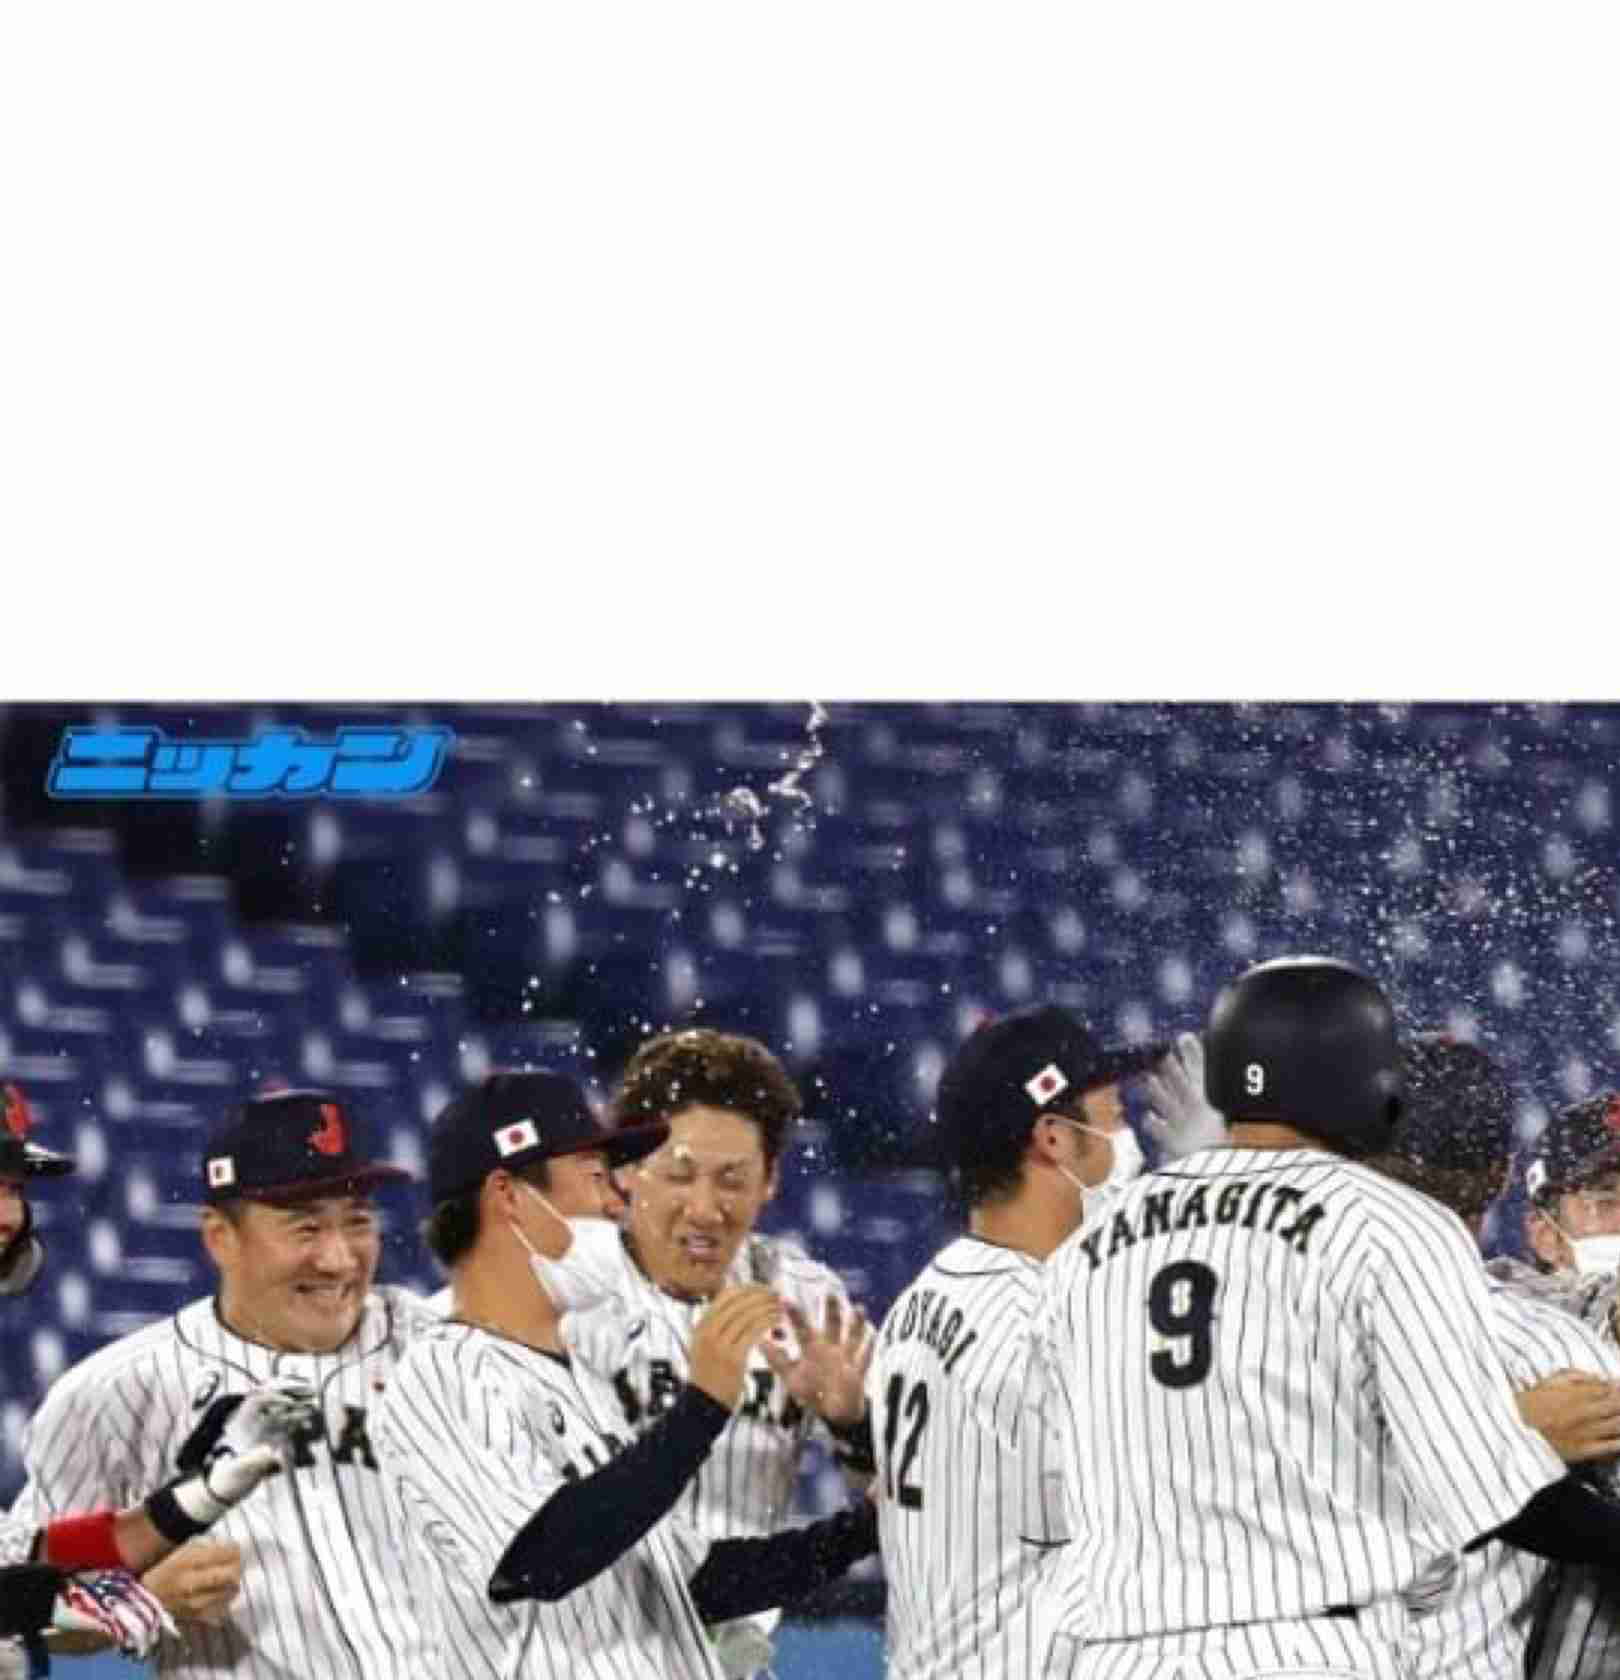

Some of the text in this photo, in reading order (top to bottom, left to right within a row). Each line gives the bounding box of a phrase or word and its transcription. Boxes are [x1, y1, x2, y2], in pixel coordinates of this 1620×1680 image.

[1246, 1063, 1265, 1096] 9
[1080, 1182, 1325, 1270] YANAGITA
[1149, 1259, 1218, 1389] 9
[885, 1372, 930, 1511] 12
